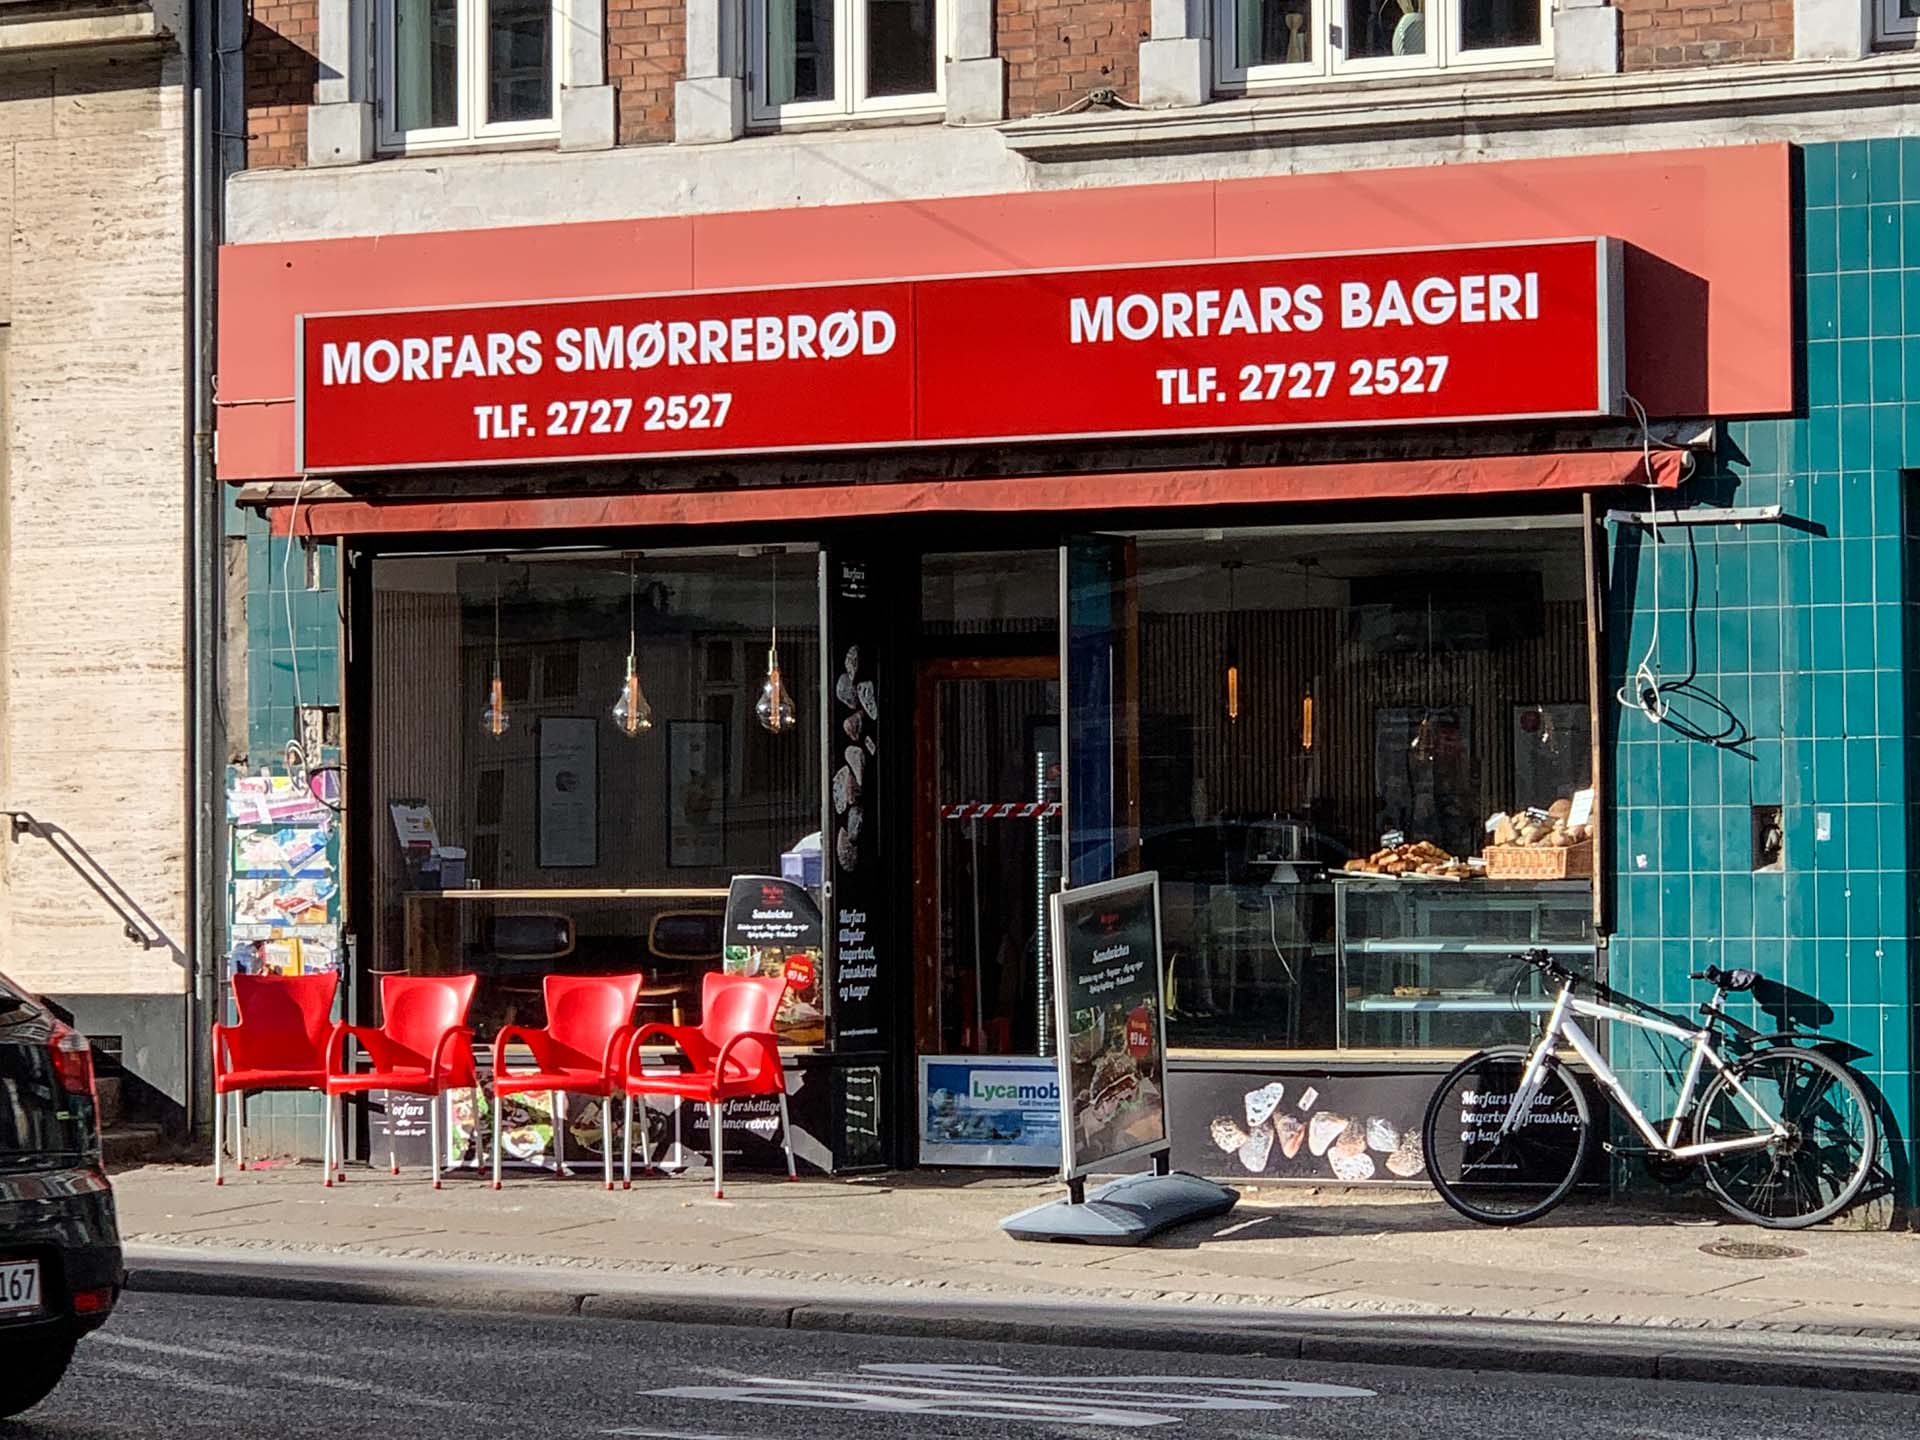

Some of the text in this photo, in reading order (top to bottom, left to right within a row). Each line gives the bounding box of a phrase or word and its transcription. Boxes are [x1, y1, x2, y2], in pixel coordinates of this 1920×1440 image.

[1070, 272, 1538, 344] MORFARS BAGERI
[322, 309, 896, 386] MORFARS SMØRREBRØD
[1157, 356, 1449, 405] TLF. 2727 2527
[474, 393, 732, 440] TLF. 2727 2527
[839, 909, 866, 928] Morfars
[1092, 944, 1130, 964] Sandwiches
[727, 1099, 780, 1115] forskellige
[1461, 1090, 1507, 1108] Morfars
[391, 1102, 424, 1119] orfars
[1461, 1128, 1500, 1146] og kag
